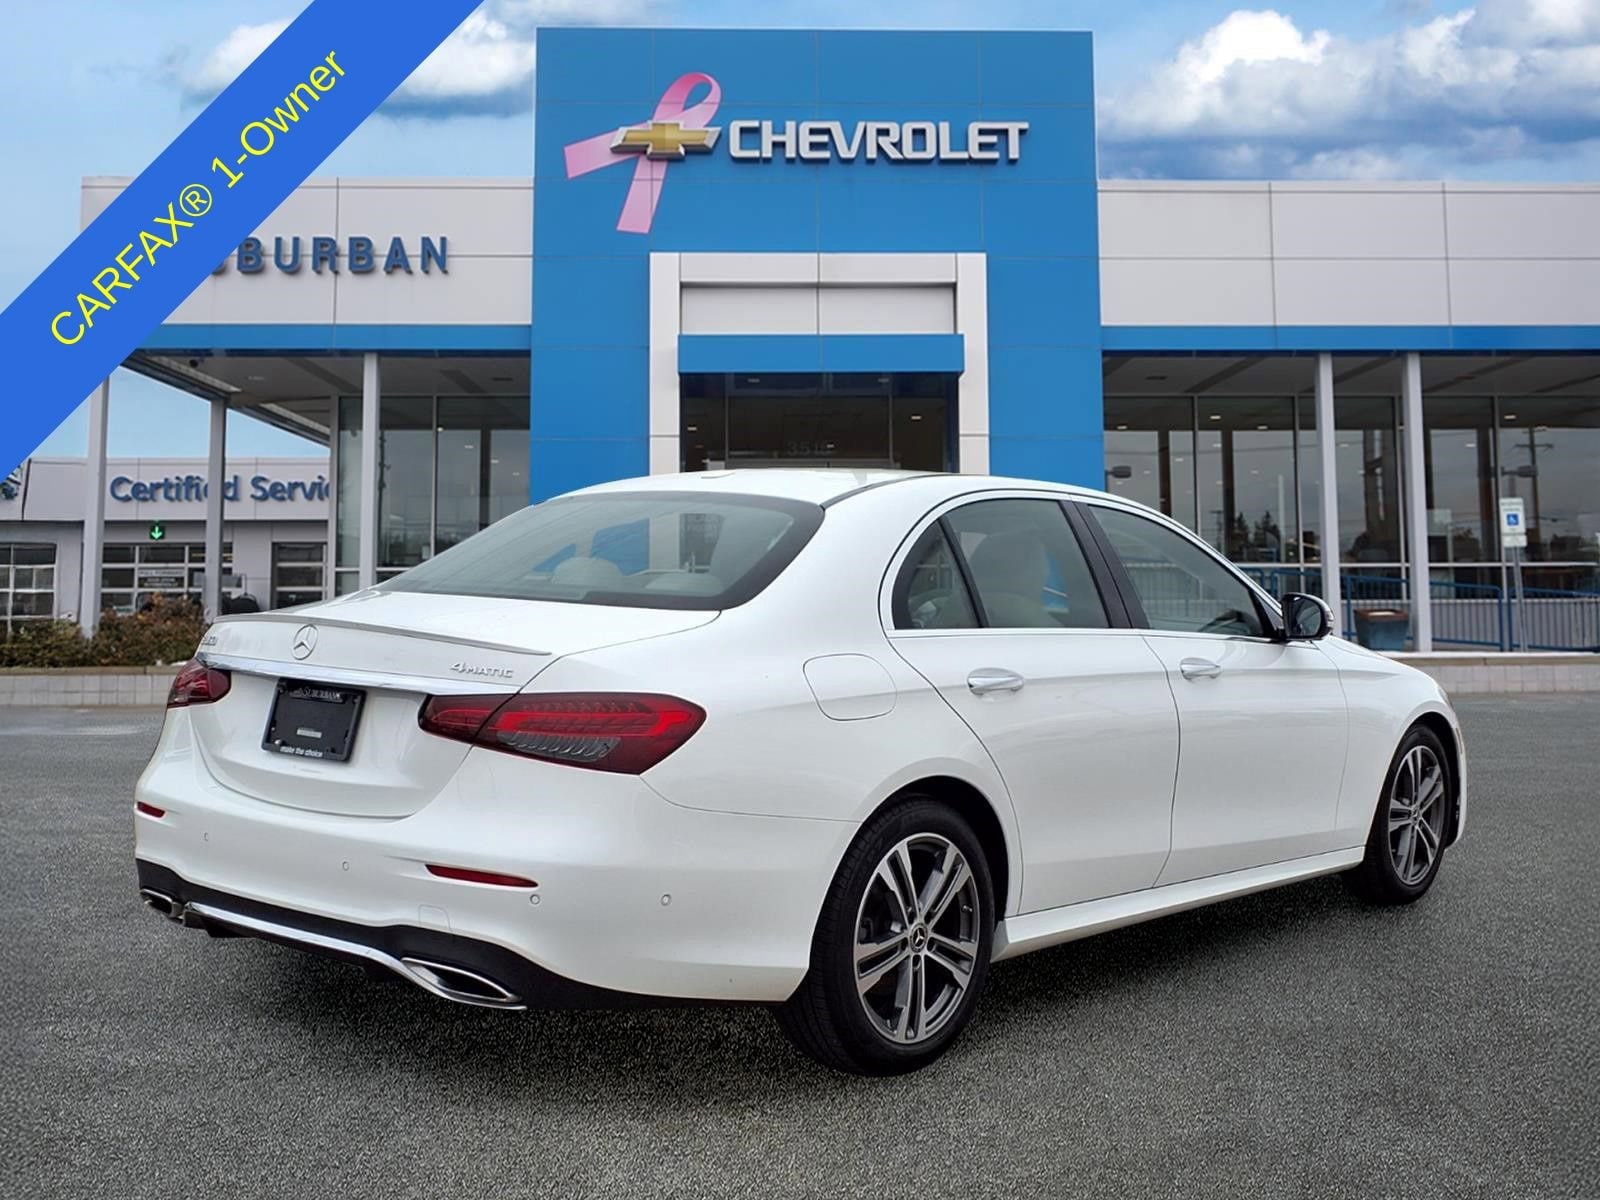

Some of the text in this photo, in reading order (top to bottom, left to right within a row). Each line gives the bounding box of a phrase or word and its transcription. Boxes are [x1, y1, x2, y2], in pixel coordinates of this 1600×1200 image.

[729, 119, 1030, 161] CHEVROLET
[212, 236, 449, 275] BURBAN
[450, 662, 514, 679] 4MATIC
